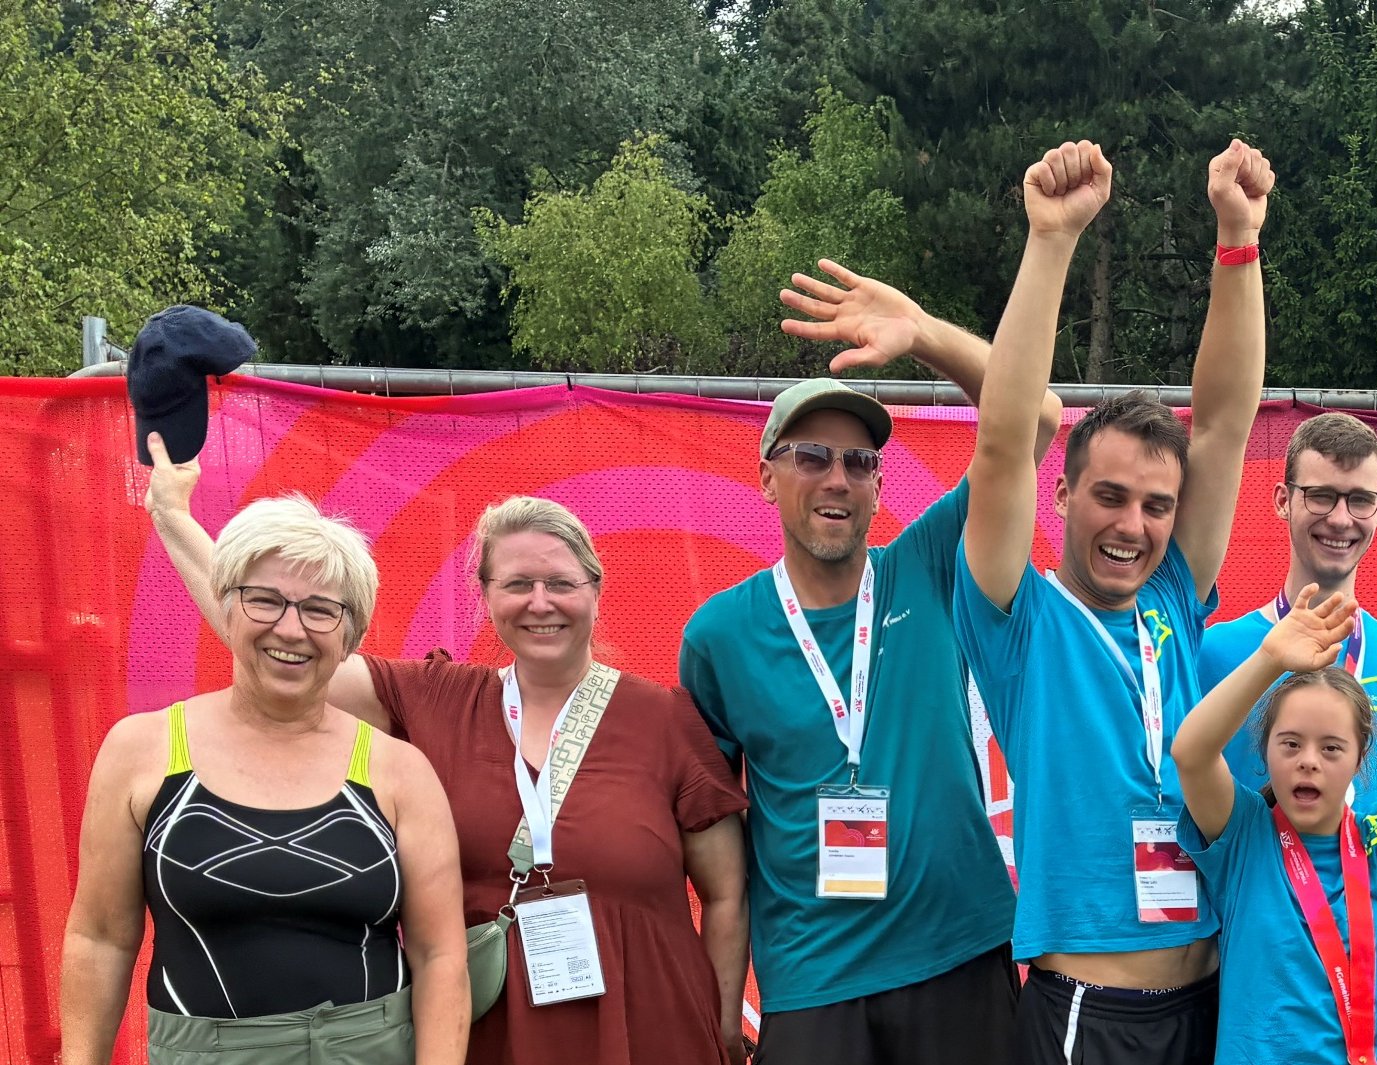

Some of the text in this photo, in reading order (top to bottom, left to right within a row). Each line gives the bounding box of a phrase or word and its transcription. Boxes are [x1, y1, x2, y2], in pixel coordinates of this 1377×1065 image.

[785, 598, 798, 616] ABB
[858, 626, 868, 645] ABB
[1144, 645, 1153, 663] ABB
[831, 698, 845, 719] ABB
